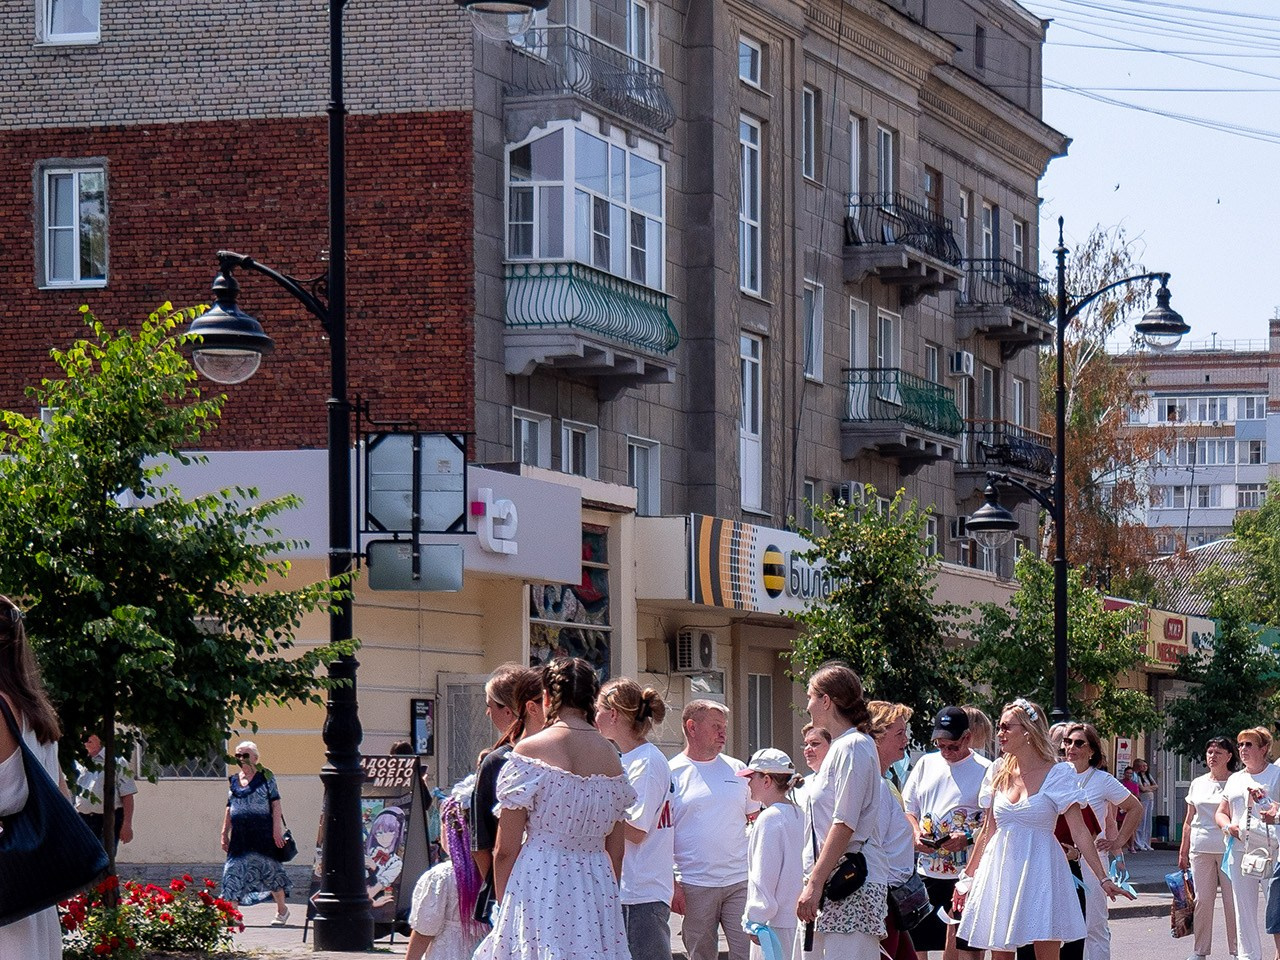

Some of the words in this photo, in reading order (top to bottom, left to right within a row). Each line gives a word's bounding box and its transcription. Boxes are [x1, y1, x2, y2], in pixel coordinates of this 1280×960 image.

[785, 551, 848, 599] била
[359, 758, 415, 769] АДОСТИ
[367, 767, 414, 778] ВСЕГО
[373, 777, 411, 787] МИРА
